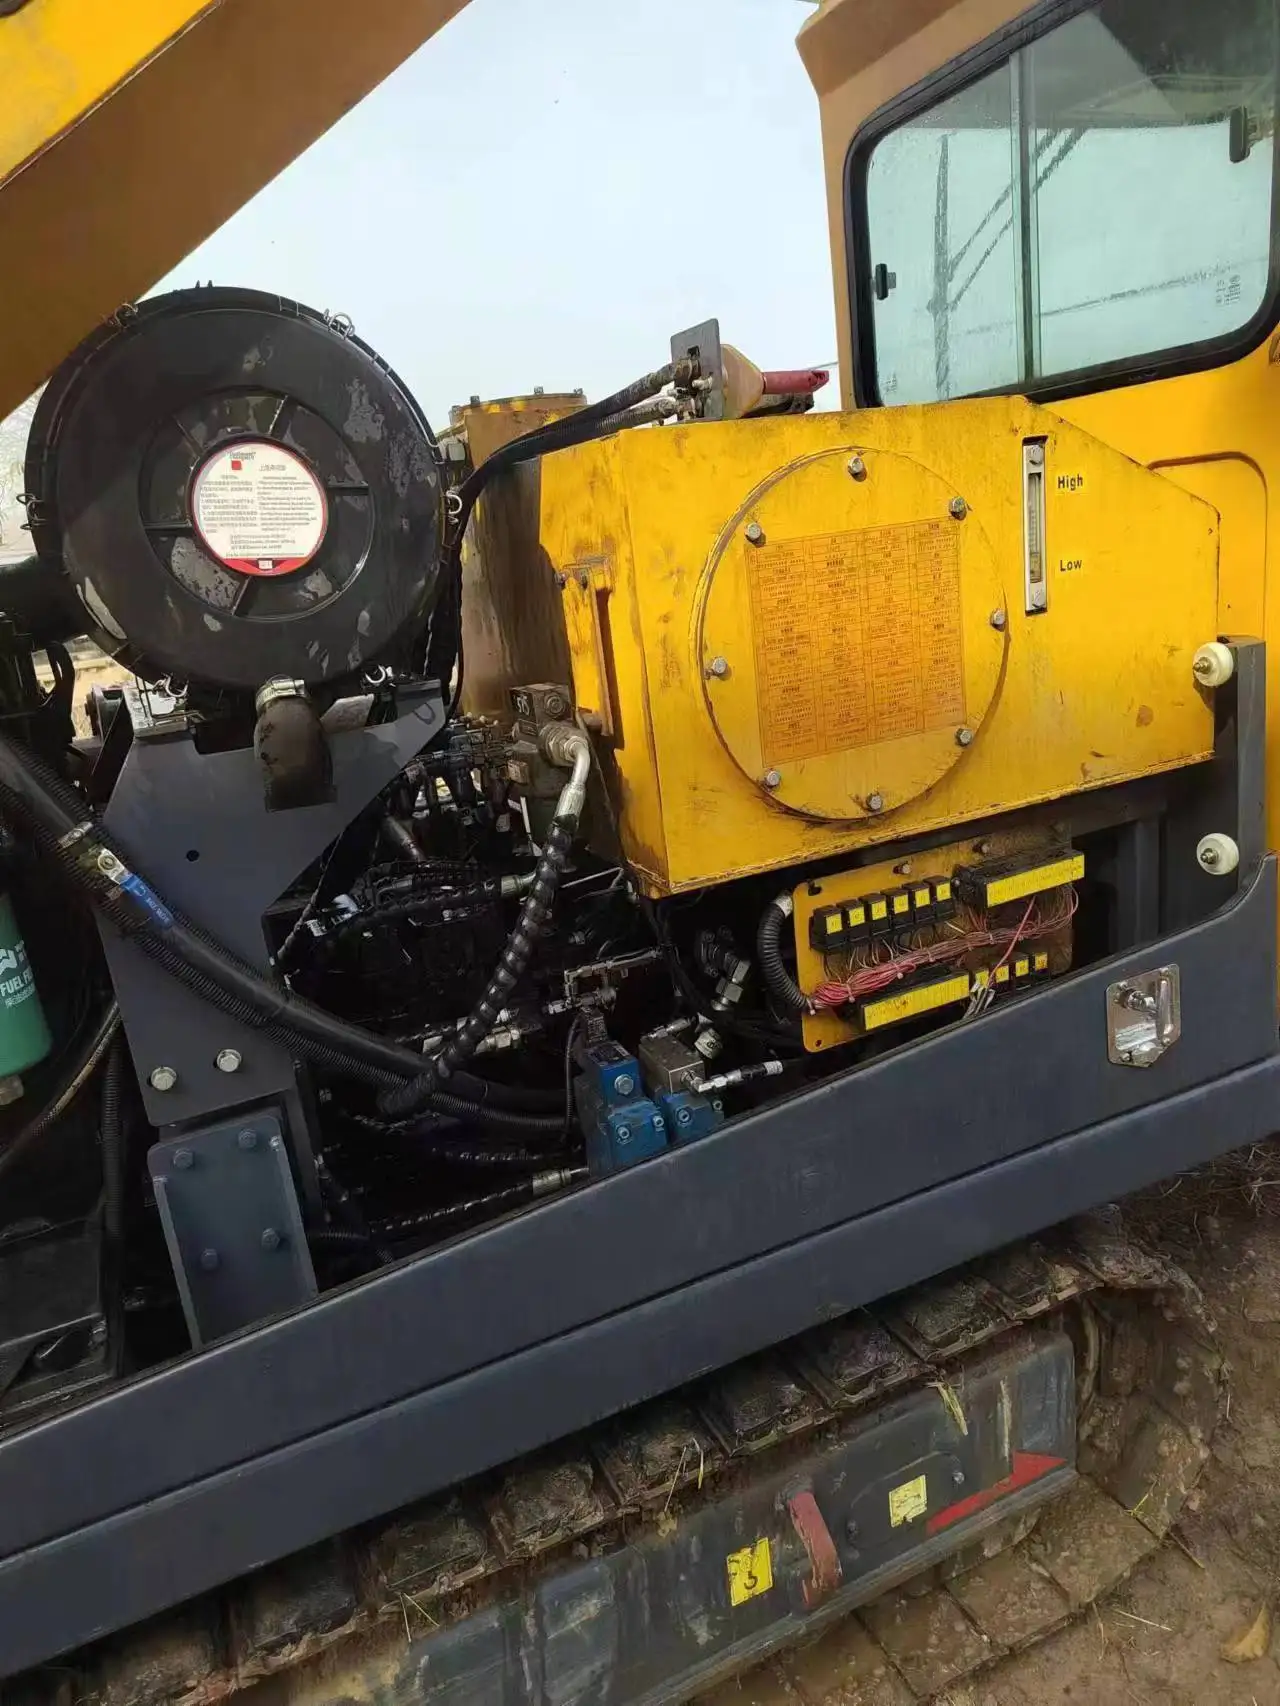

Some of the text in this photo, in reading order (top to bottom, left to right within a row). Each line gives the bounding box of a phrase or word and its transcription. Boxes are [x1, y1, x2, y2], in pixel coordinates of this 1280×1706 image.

[1058, 475, 1083, 491] High
[1060, 560, 1082, 572] Low
[0, 976, 24, 997] FUEL
